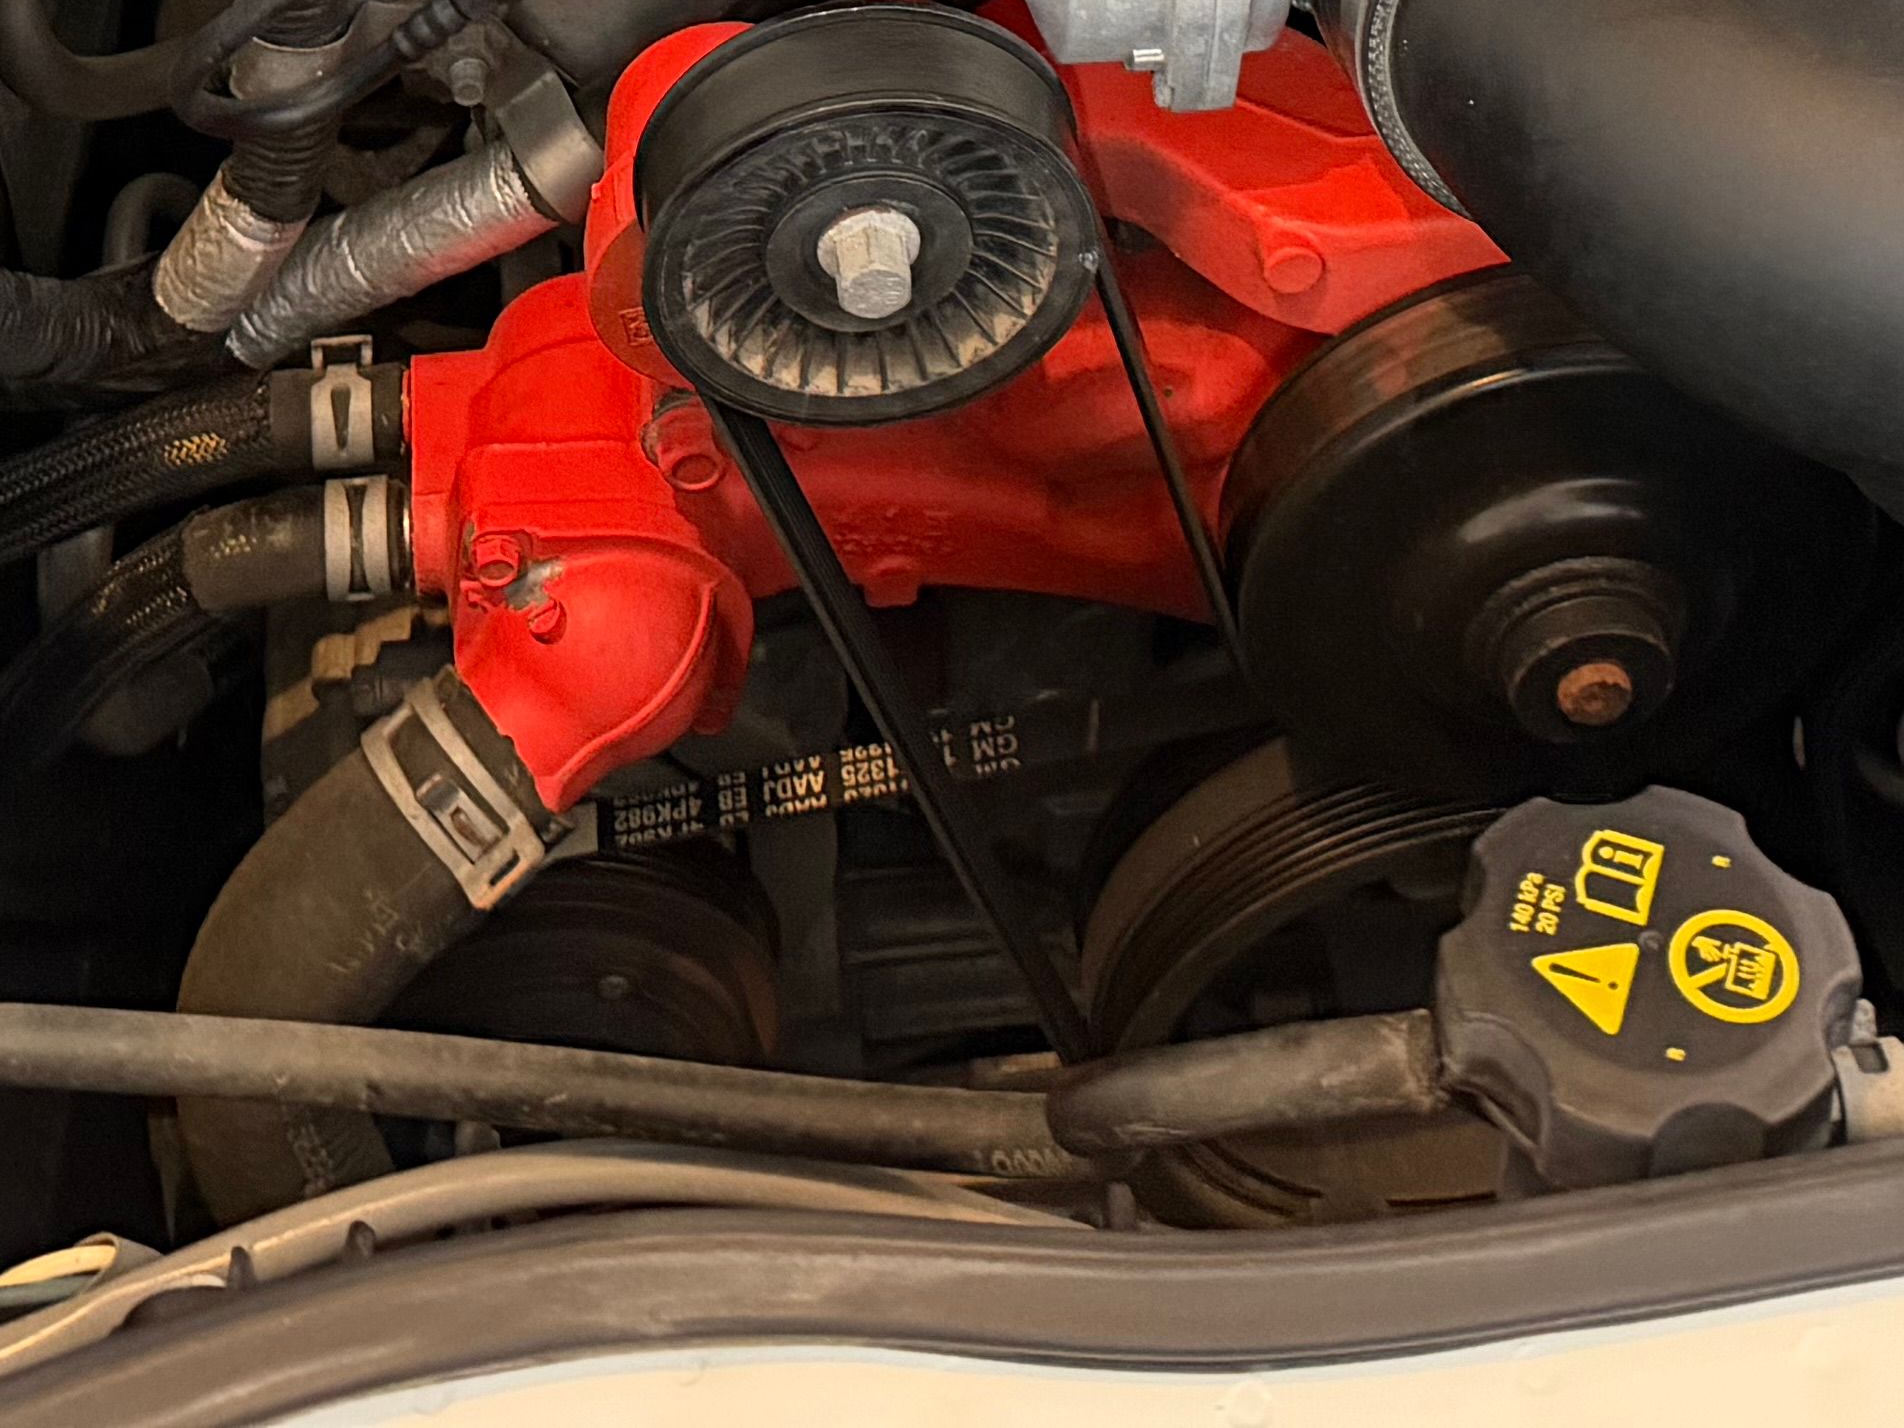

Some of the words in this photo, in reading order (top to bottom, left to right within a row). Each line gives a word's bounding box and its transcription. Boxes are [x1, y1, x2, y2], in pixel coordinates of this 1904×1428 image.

[971, 733, 1018, 762] GM
[717, 786, 748, 812] EB
[763, 770, 825, 801] AADJ
[613, 796, 702, 832] 4PK982
[1516, 872, 1545, 903] kPa
[1540, 883, 1567, 913] PSI
[1508, 903, 1536, 932] 140
[1535, 912, 1560, 936] 20
